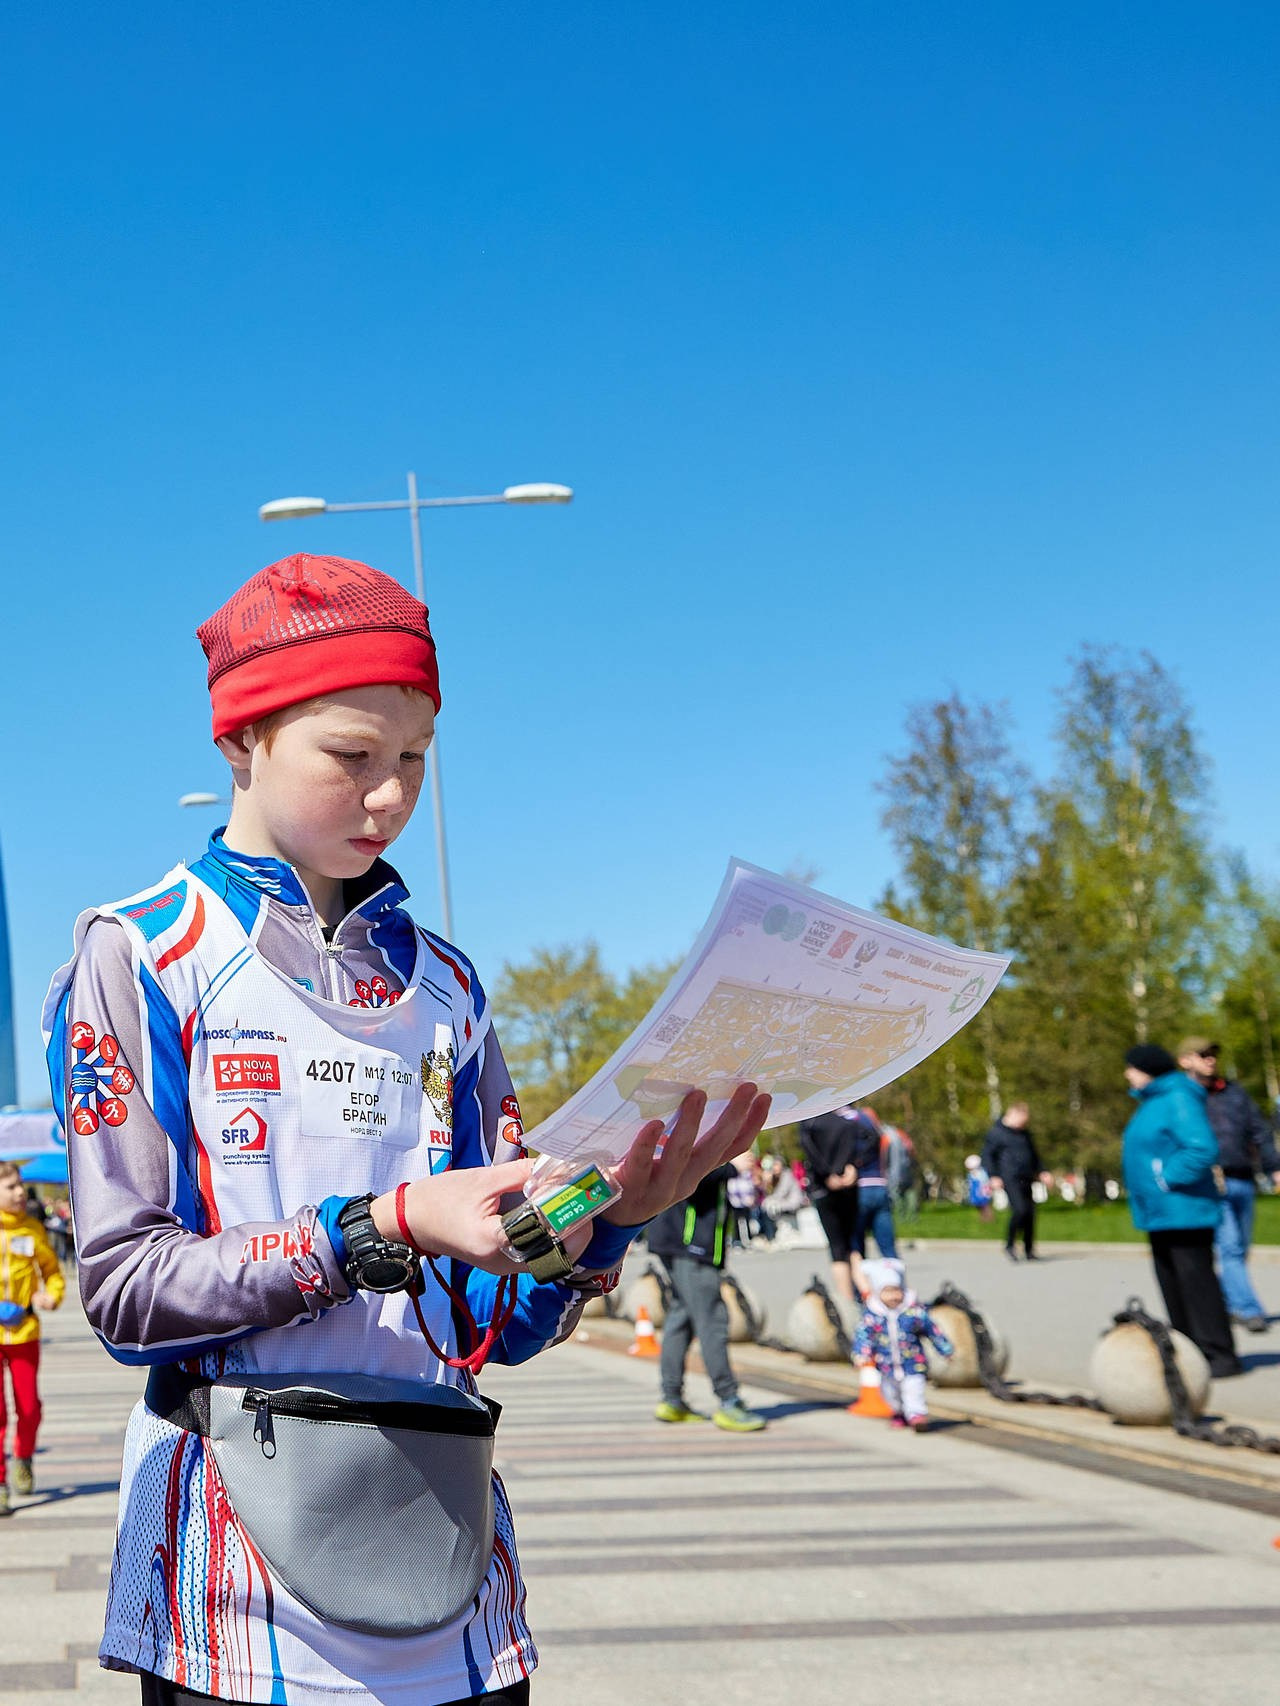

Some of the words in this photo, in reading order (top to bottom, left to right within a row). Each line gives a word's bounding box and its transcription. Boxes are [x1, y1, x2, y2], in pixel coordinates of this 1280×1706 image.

[243, 1060, 272, 1070] NOVA
[306, 1059, 355, 1084] 4207
[391, 1070, 413, 1086] 12:07
[245, 1072, 274, 1082] TOUR
[350, 1091, 380, 1107] ЕГОР
[342, 1108, 387, 1126] БРАГИН
[222, 1128, 250, 1144] SFR
[350, 1127, 366, 1135] НОРД
[429, 1130, 452, 1146] RU
[573, 1203, 585, 1214] C4
[557, 1211, 574, 1225] card
